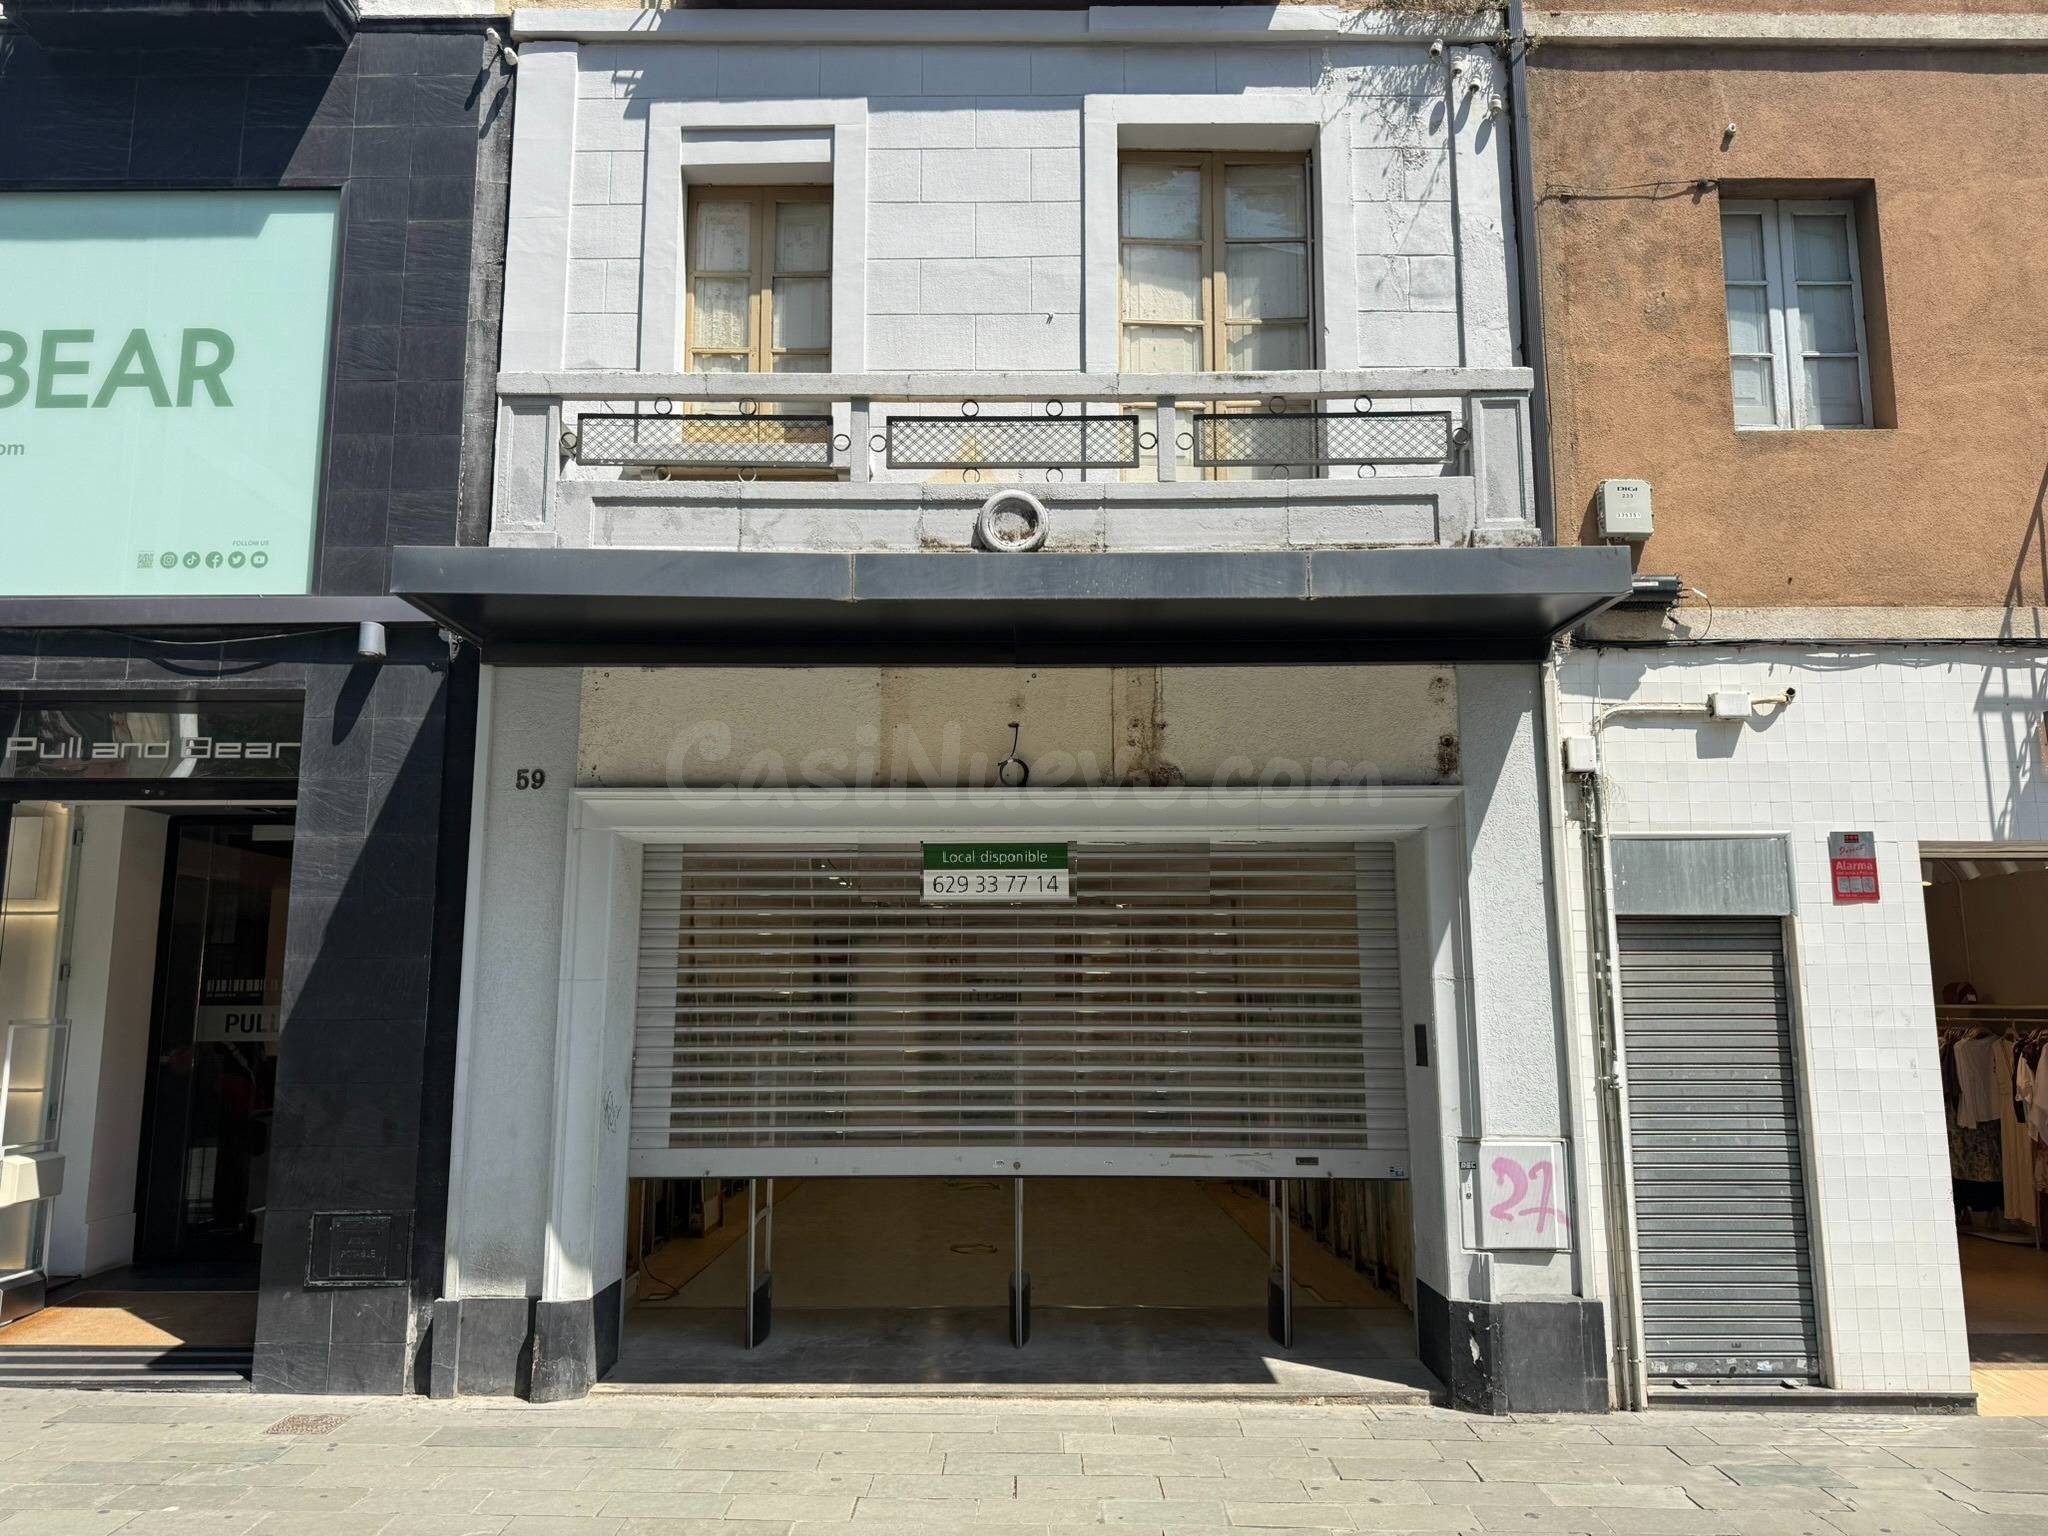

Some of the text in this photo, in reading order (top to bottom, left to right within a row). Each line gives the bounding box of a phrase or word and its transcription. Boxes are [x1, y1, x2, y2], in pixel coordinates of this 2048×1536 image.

[6, 737, 302, 759] Pull and Bear
[516, 768, 546, 790] 59
[942, 850, 1048, 864] Local disponible
[1835, 861, 1873, 871] Alarma
[933, 875, 1059, 893] 629 33 77 14
